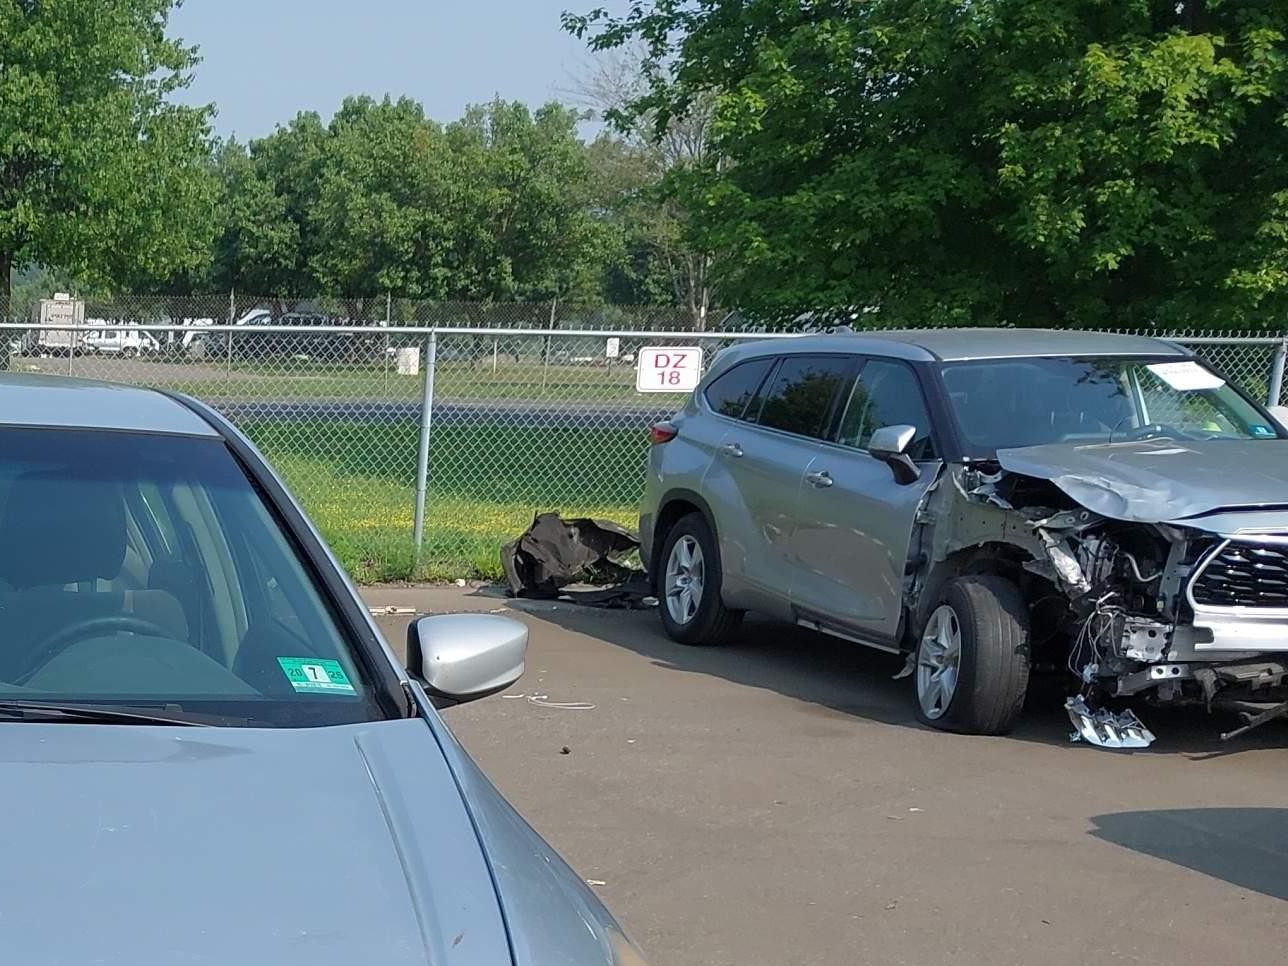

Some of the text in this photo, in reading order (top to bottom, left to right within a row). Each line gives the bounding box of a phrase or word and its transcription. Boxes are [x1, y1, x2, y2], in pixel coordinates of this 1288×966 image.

[654, 354, 688, 369] DZ
[657, 371, 681, 385] 18
[287, 668, 303, 677] 20
[308, 667, 318, 680] 7
